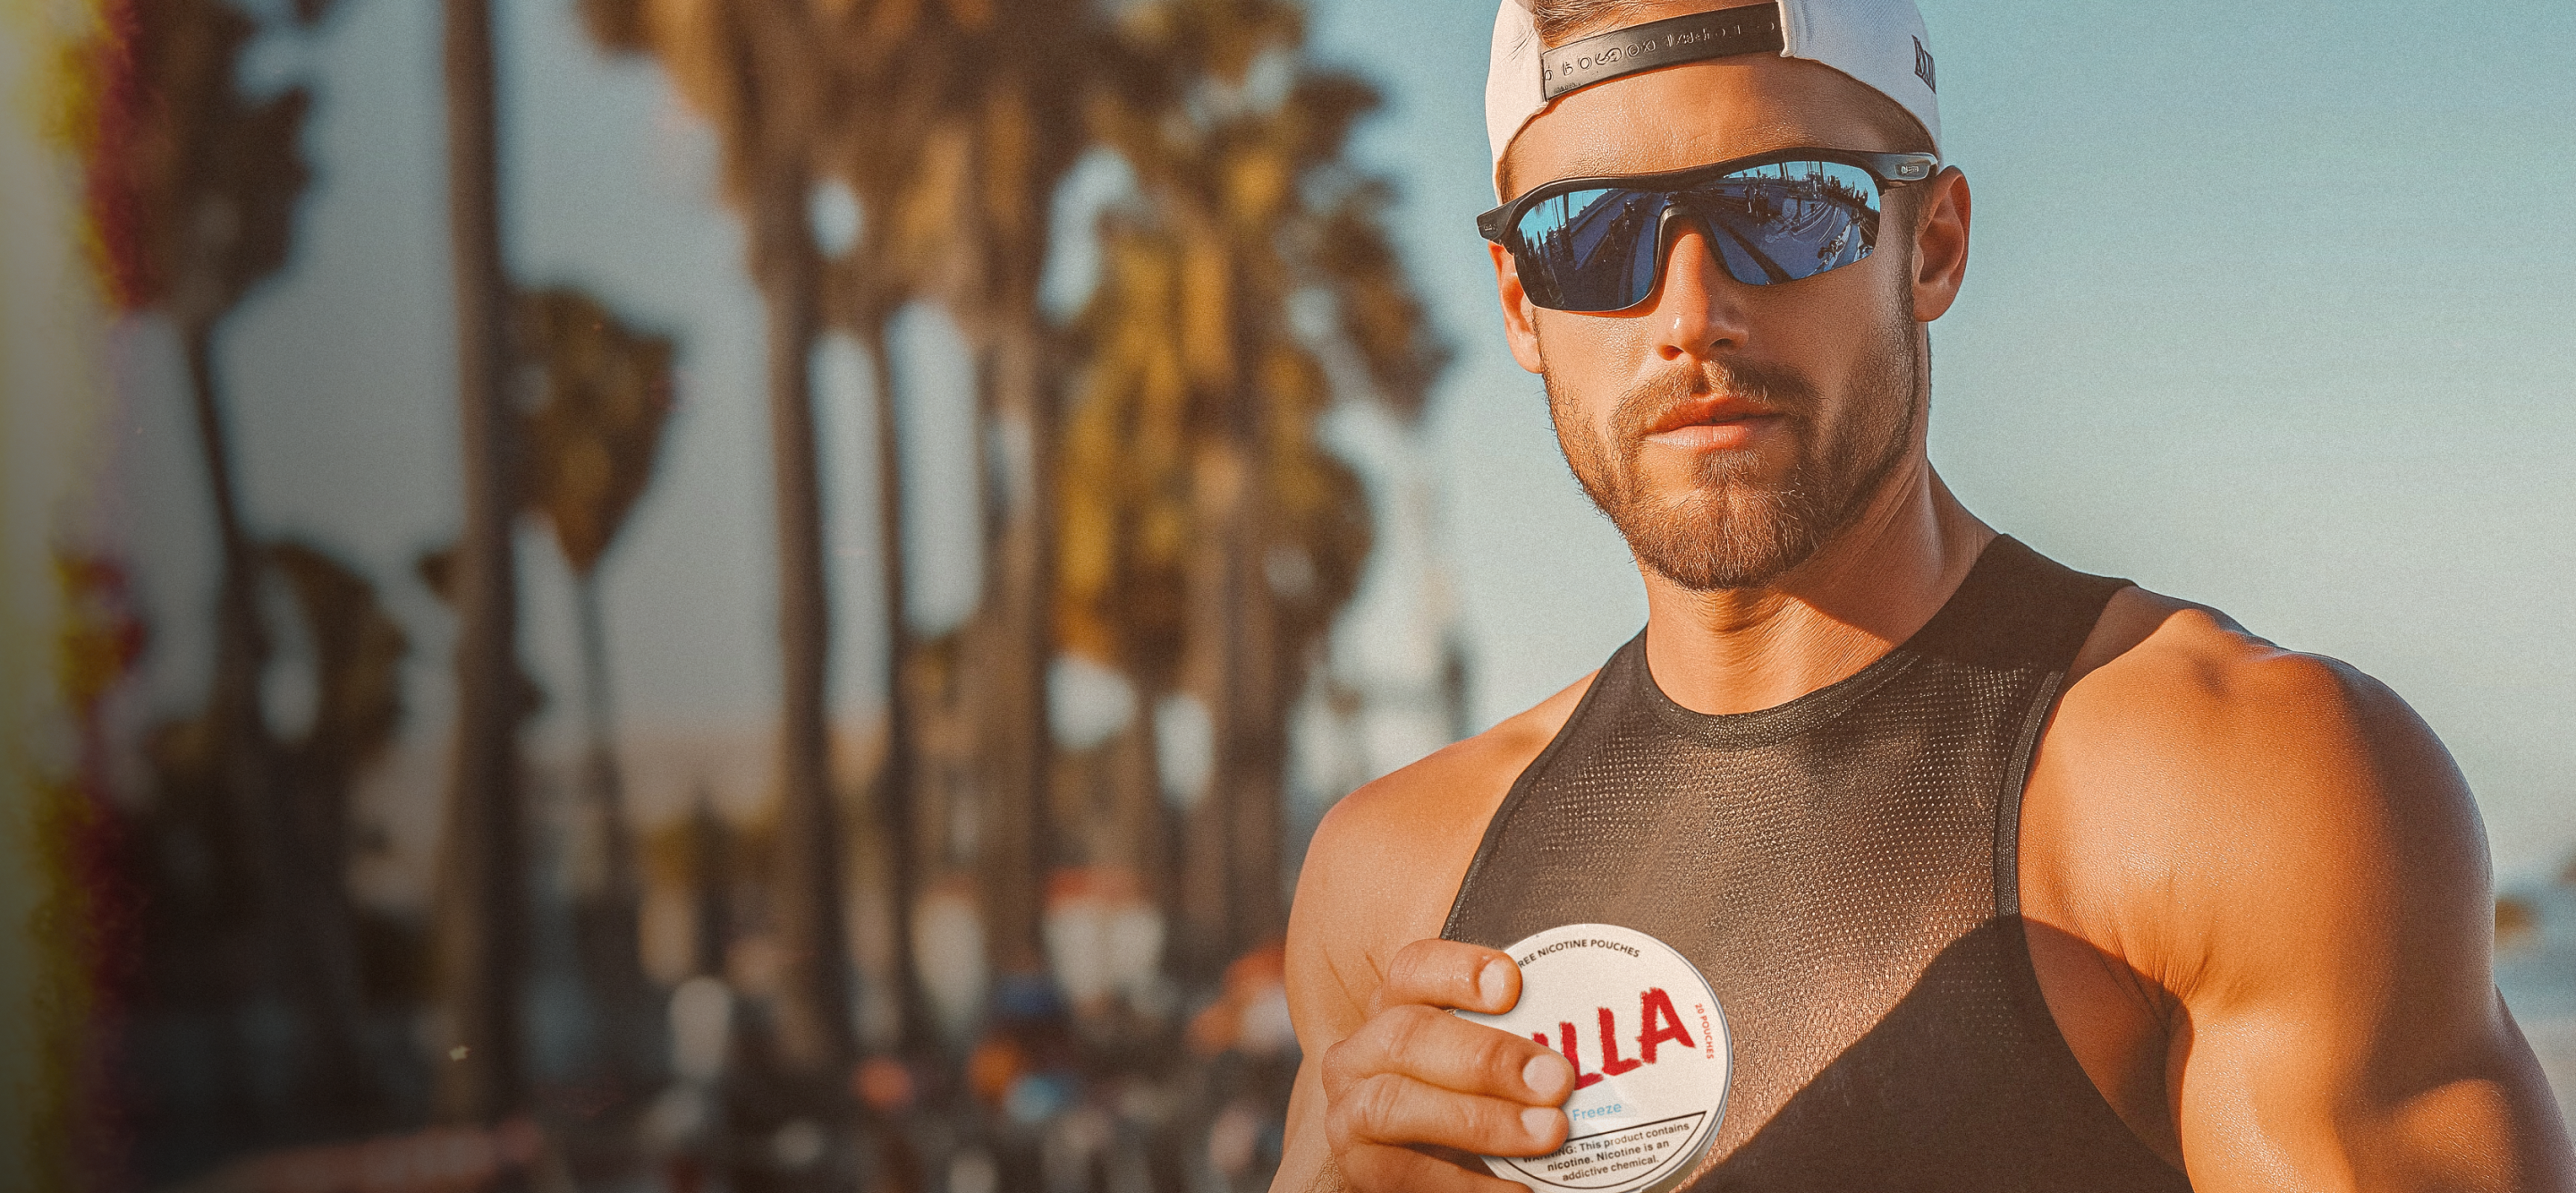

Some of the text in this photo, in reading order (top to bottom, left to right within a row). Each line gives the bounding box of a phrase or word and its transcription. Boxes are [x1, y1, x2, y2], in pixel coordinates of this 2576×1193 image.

[1517, 939, 1640, 969] REE NICOTINE POUCHES
[1532, 986, 1696, 1091] LLA
[1694, 1003, 1715, 1060] 20 POUCHES
[1572, 1103, 1623, 1121] Freeze
[1580, 1141, 1601, 1152] This
[1604, 1132, 1643, 1147] product
[1646, 1122, 1690, 1138] contains
[1547, 1140, 1669, 1172] nicotine. Nicotine is an
[1563, 1155, 1659, 1181] addictive chemical.
